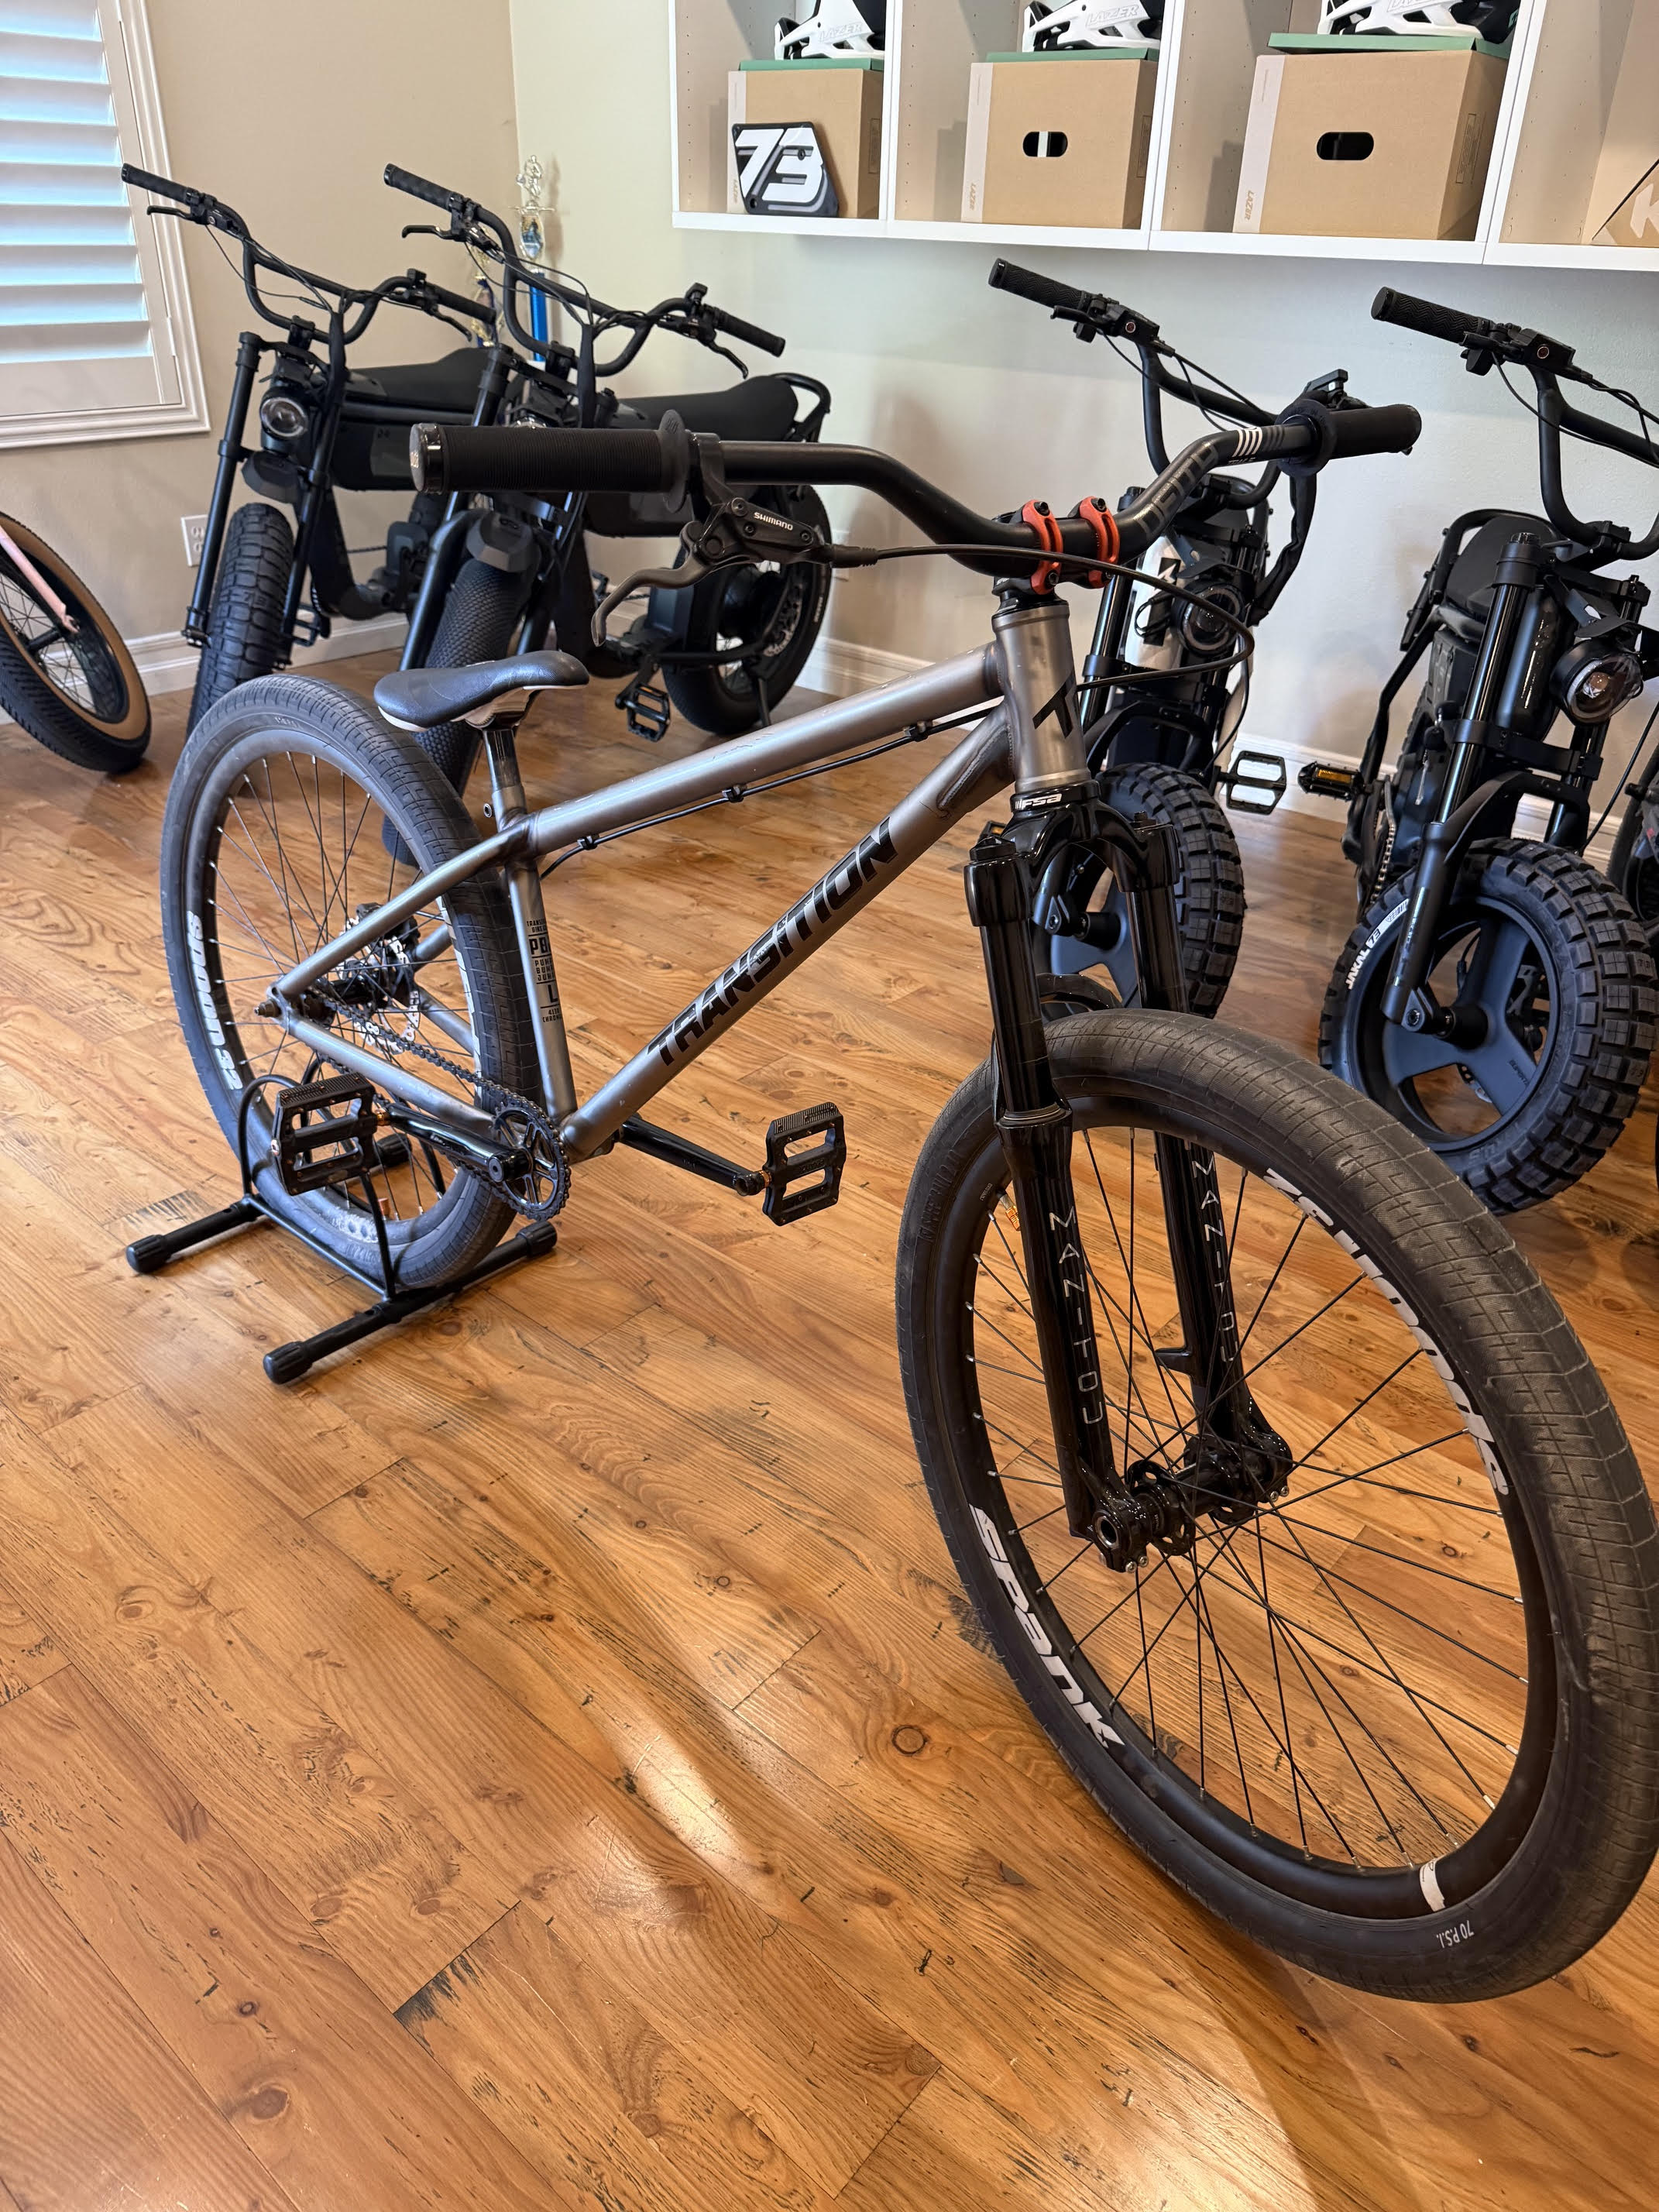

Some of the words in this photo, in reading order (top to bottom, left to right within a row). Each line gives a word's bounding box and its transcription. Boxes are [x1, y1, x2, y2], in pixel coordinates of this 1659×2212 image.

[1089, 5, 1139, 23] LAZER
[735, 128, 823, 203] 73
[1245, 190, 1255, 220] LAZER
[754, 511, 794, 531] SHIMANO
[1020, 793, 1062, 810] FSA
[647, 816, 898, 1066] TRANSITION
[1345, 949, 1370, 990] JAKAL
[215, 1048, 243, 1090] 32
[1192, 1153, 1239, 1362] MANITOU
[1049, 1206, 1104, 1424] MANITOU
[1436, 1927, 1460, 1948] P.S.I.
[1459, 1920, 1475, 1939] 70
